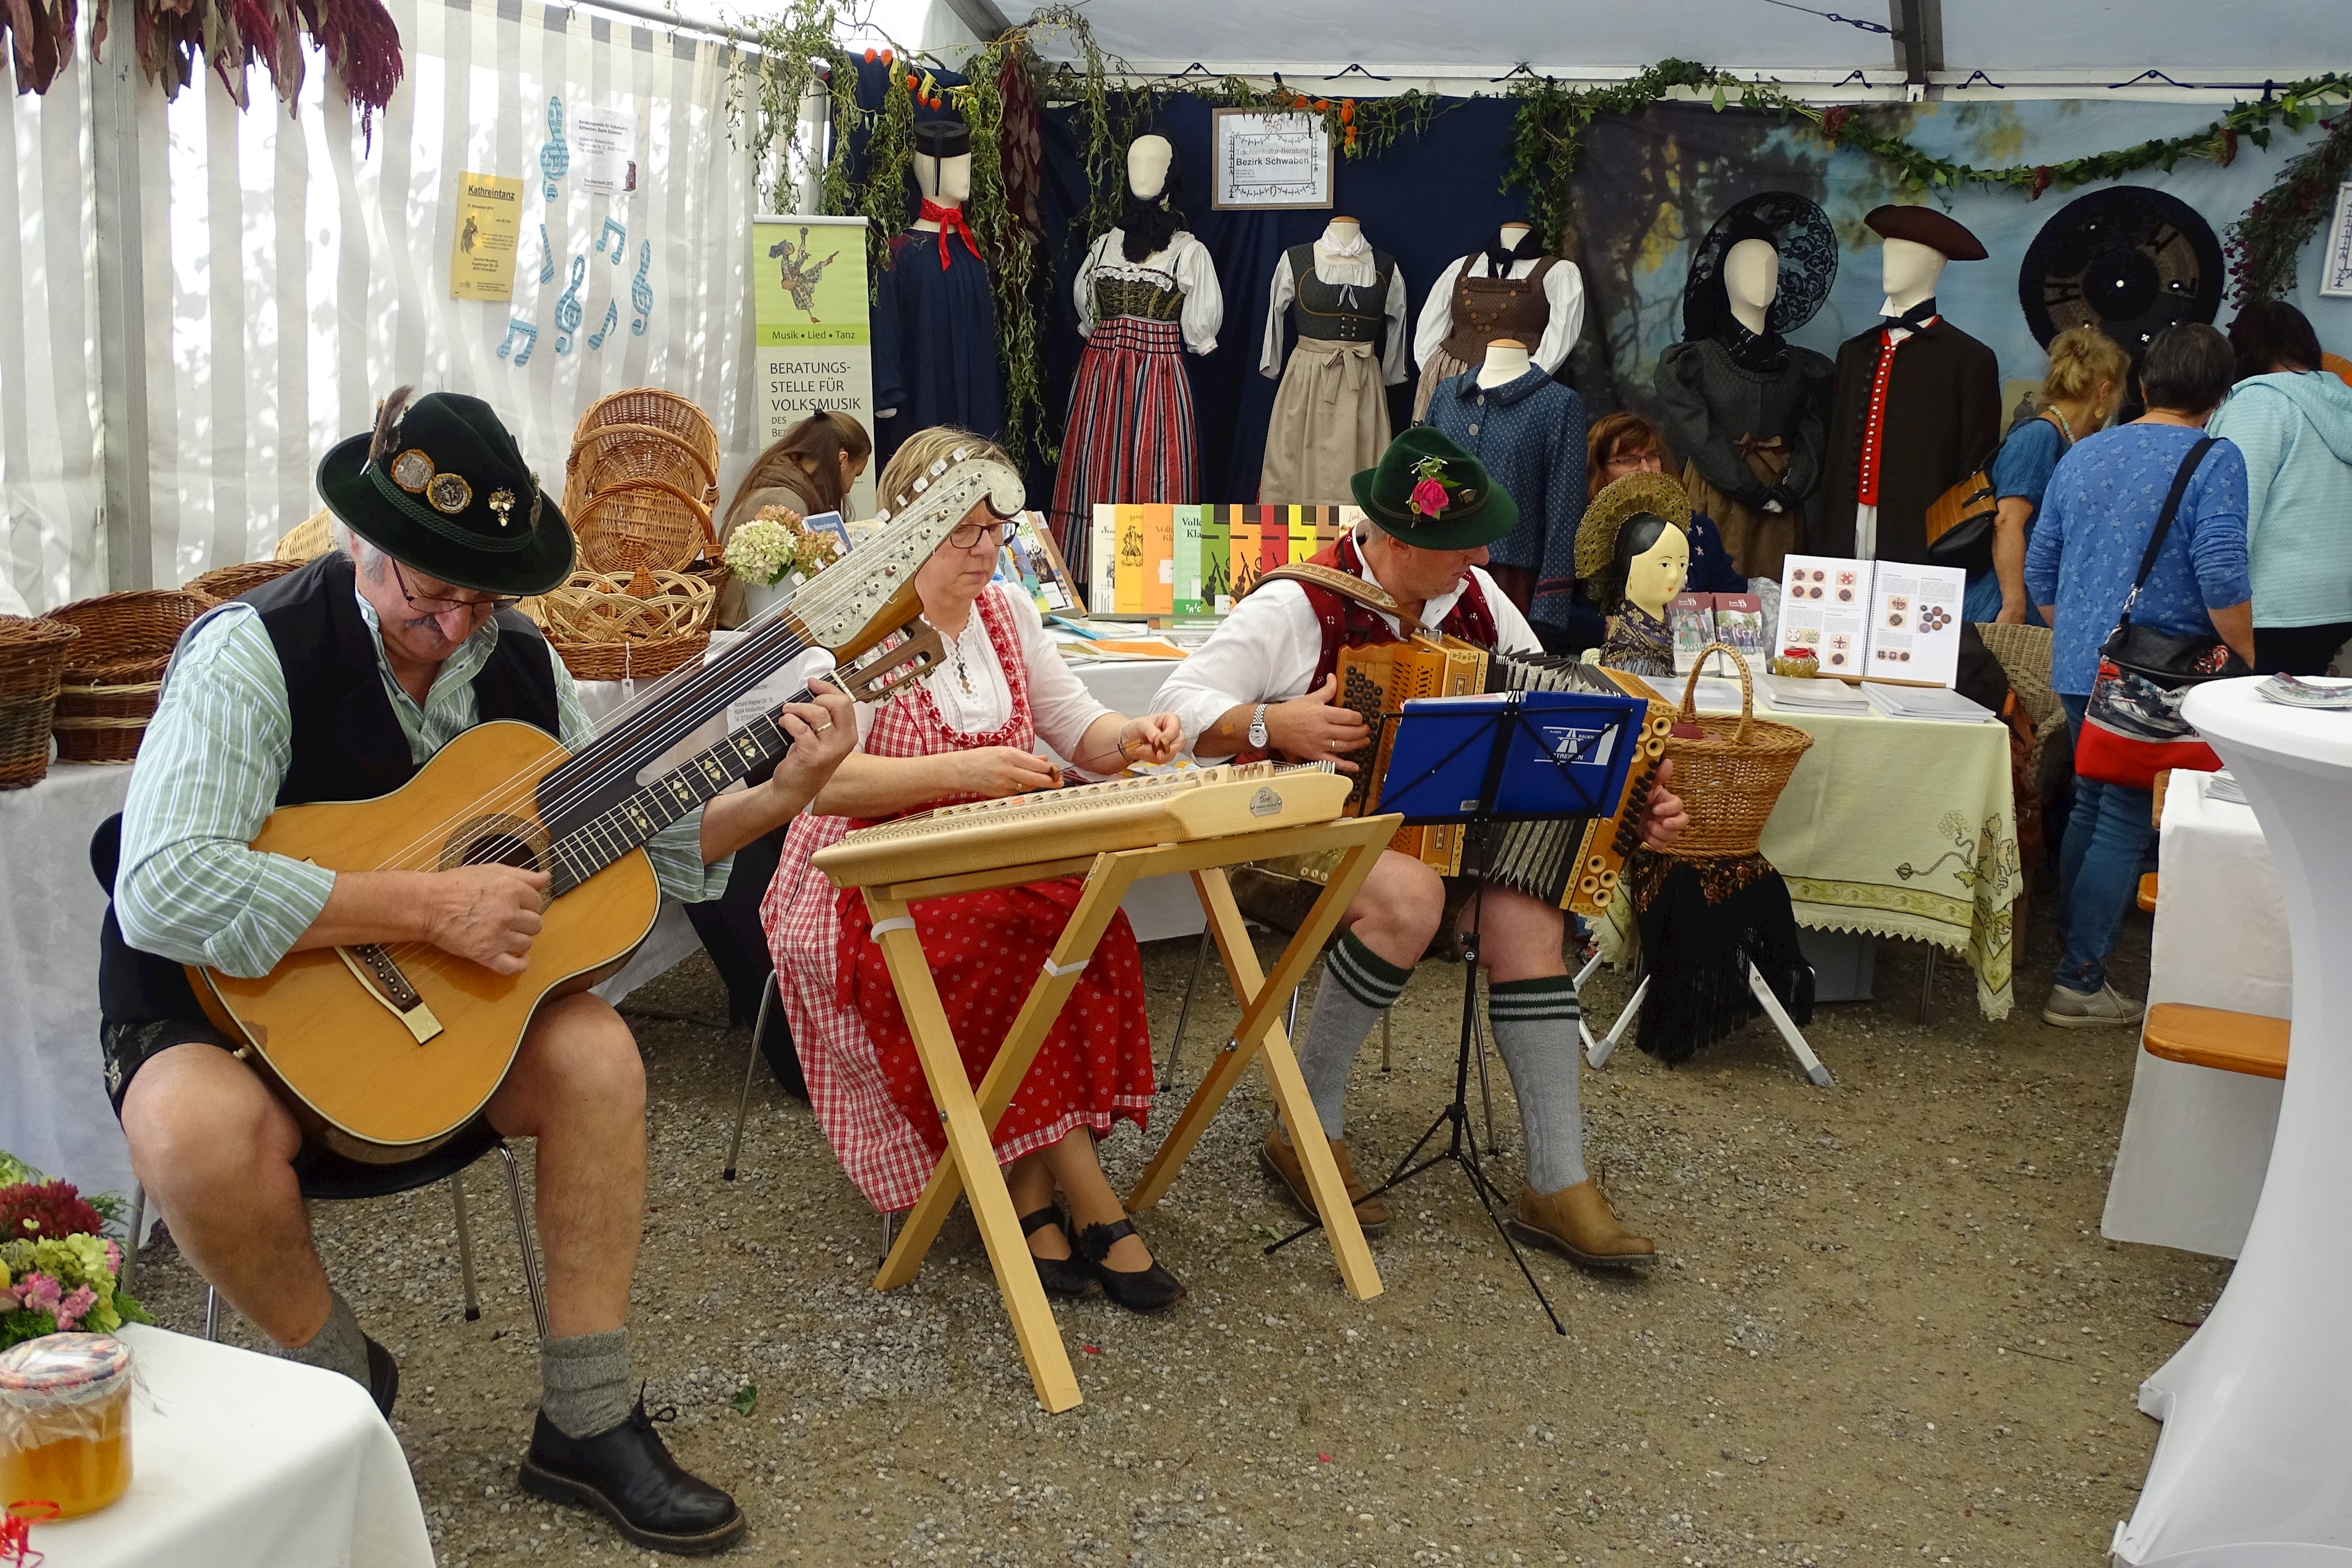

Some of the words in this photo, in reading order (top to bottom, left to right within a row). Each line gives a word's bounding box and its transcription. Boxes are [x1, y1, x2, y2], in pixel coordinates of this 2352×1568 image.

[1265, 157, 1309, 165] Schwaben
[469, 185, 514, 199] Kathreintanz
[772, 331, 798, 339] Musik
[808, 331, 826, 339] Lied
[835, 331, 855, 339] Tanz
[770, 362, 851, 374] BERATUNGS-
[771, 381, 815, 393] STELLE
[820, 377, 844, 392] FÜR
[772, 398, 861, 411] VOLKSMUSIK
[1182, 518, 1201, 526] Volk
